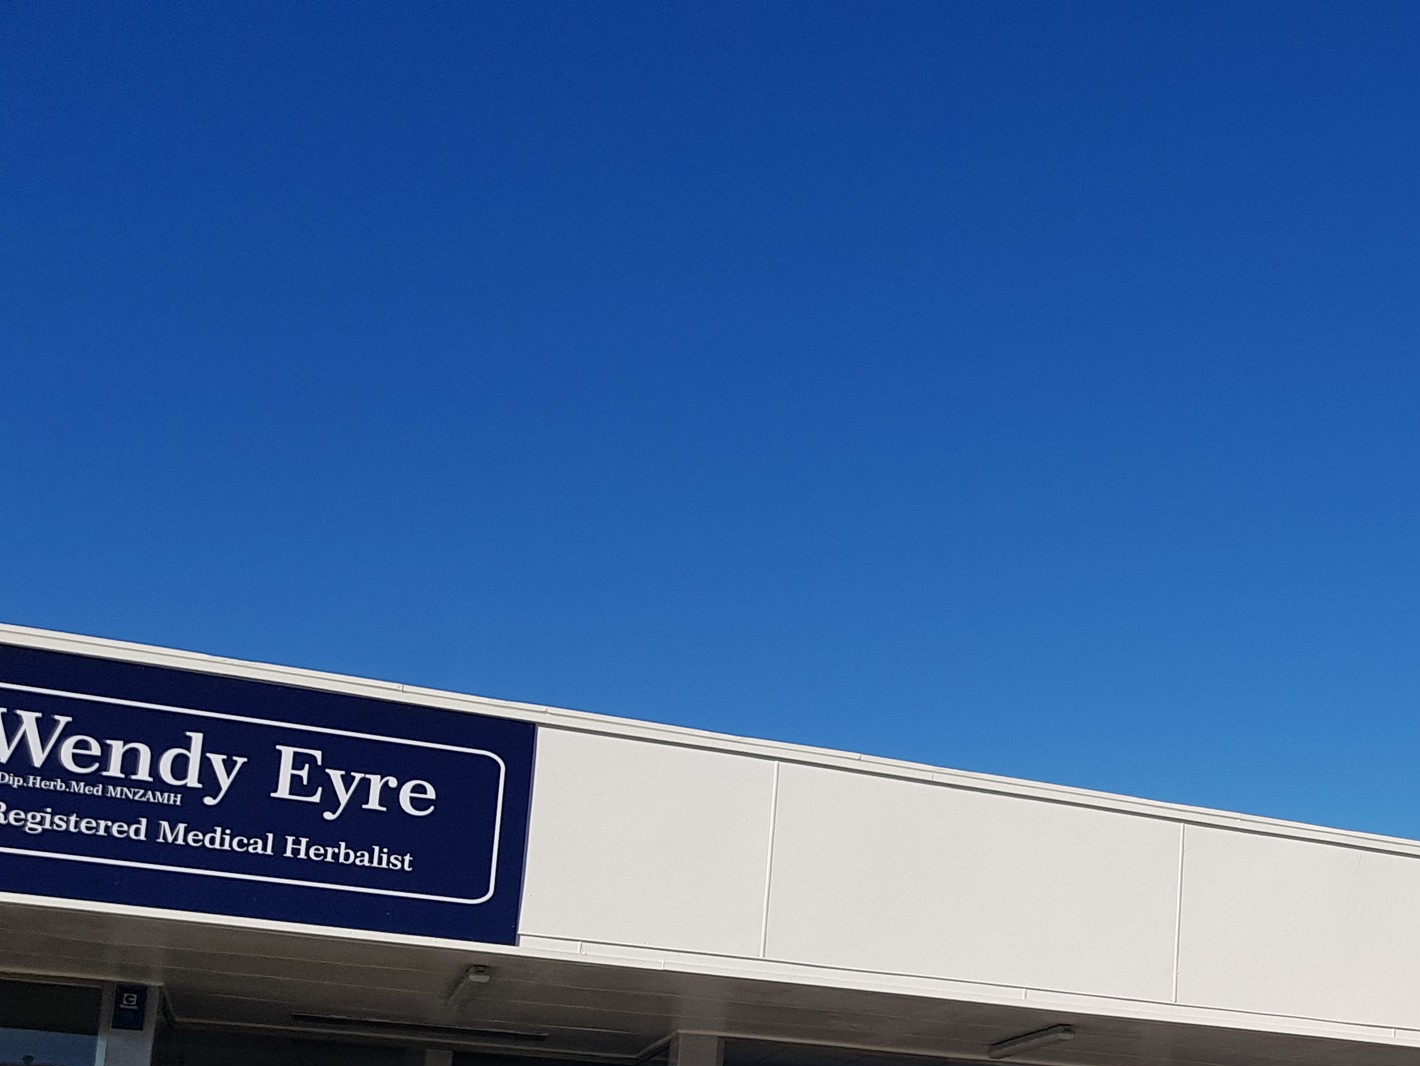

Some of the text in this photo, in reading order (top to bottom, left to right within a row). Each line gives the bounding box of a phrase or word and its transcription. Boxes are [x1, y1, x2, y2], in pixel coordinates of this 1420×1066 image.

[0, 706, 437, 821] Wendy Eyre
[106, 785, 182, 806] MNZAMH
[156, 821, 274, 855] Medical
[283, 835, 414, 872] Herbalist
